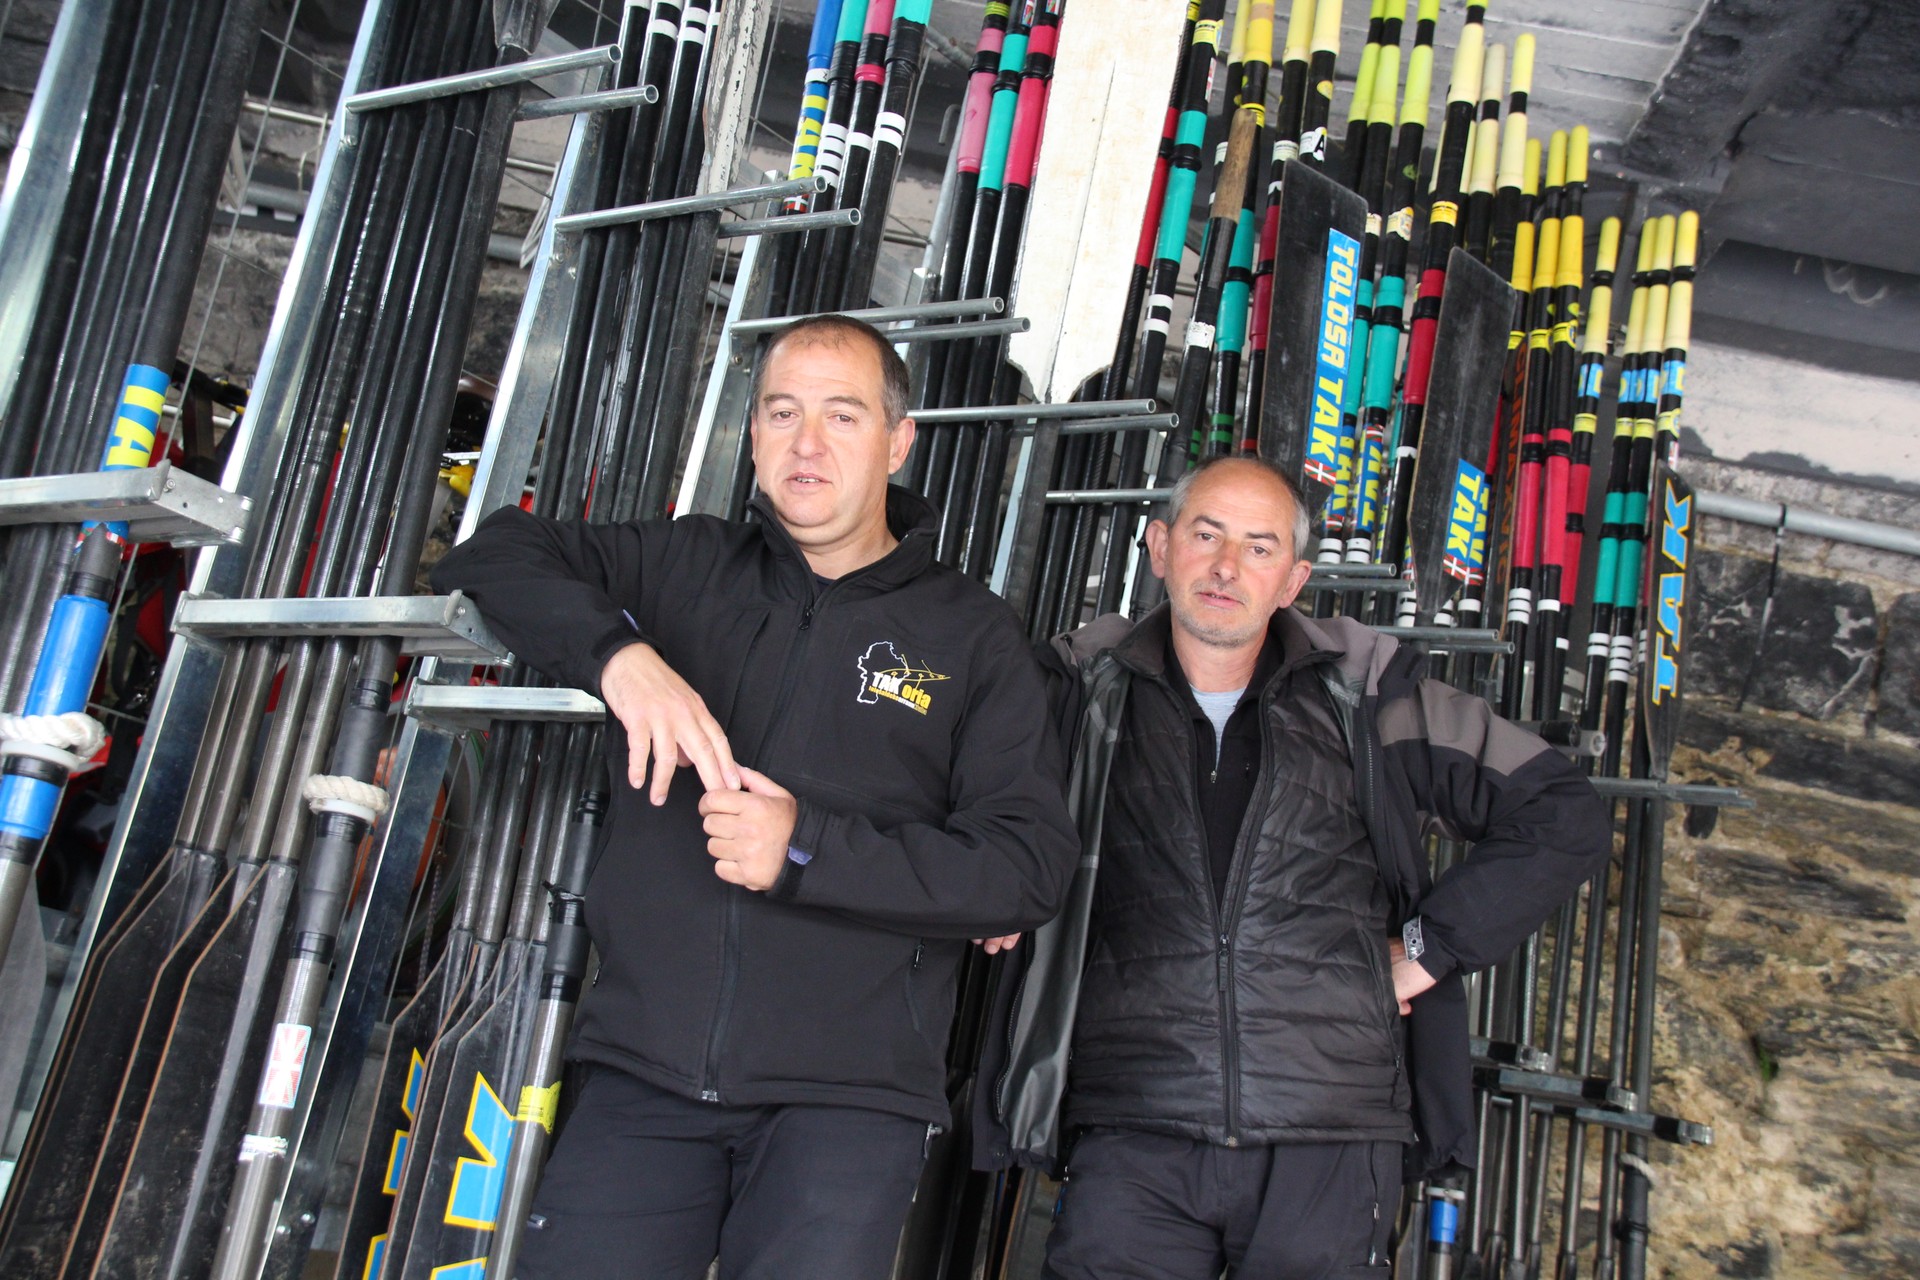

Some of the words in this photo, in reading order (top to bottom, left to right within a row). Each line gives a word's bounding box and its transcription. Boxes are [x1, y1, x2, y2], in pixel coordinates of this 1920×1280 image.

[1321, 243, 1356, 370] TOLOSA
[1309, 373, 1344, 464] TAK
[1447, 472, 1481, 559] TAK
[1652, 477, 1692, 706] TAK
[872, 671, 904, 695] TAK
[901, 684, 932, 709] oria
